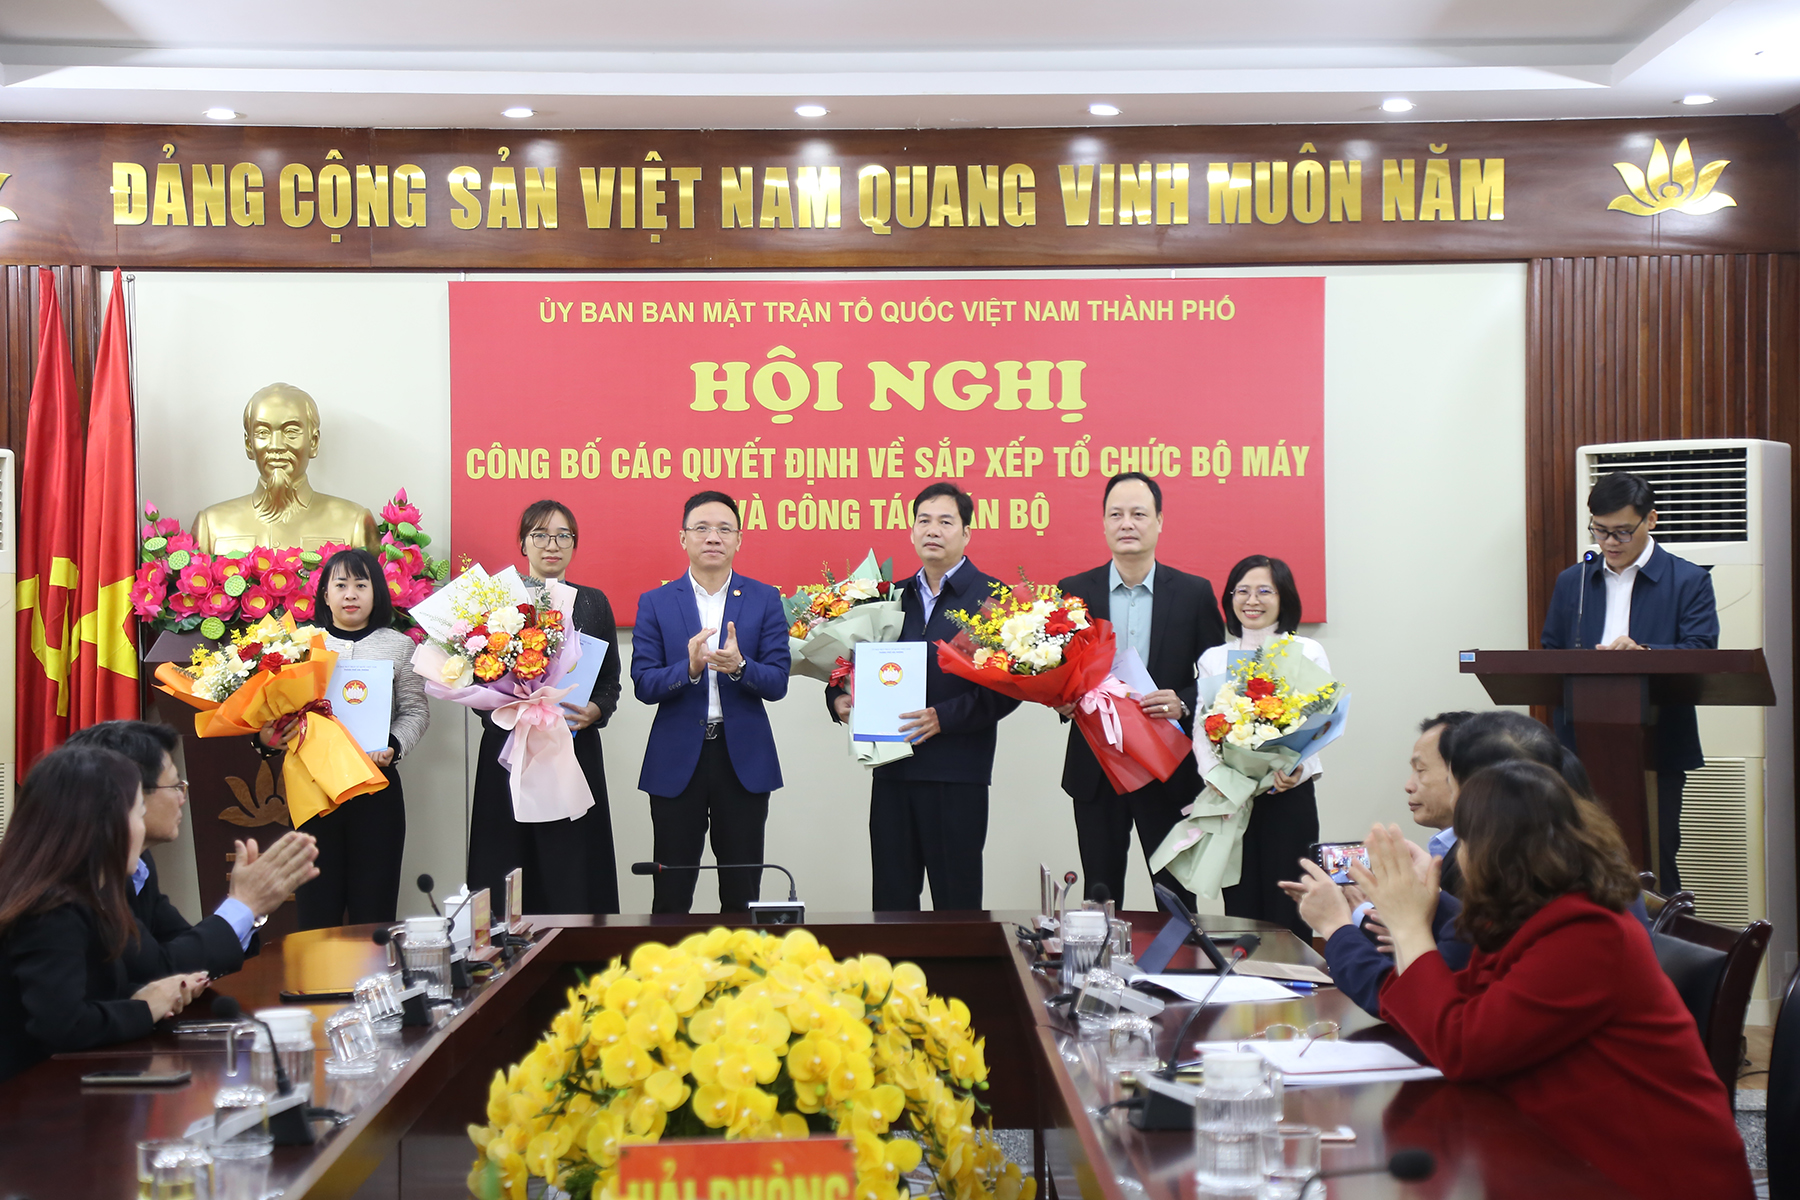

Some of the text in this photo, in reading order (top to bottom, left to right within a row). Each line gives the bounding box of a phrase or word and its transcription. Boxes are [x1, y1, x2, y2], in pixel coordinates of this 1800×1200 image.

[111, 142, 1506, 245] ĐẢNG CỘNG SẢN VIỆT NAM QUANG VINH MUÔN NĂM
[539, 294, 1236, 328] ỦY BAN BAN MẶT TRẬN TỔ QUỐC VIỆT NAM THÀNH PHỐ
[689, 344, 1088, 425] HỘI NGHỊ
[466, 434, 1311, 486] CÔNG BỐ CÁC QUYẾT ĐỊNH VỀ SẮP XẾP TỔ CHỨC BỘ MÁY
[777, 493, 861, 531] CÔNG
[1009, 491, 1050, 537] BỘ
